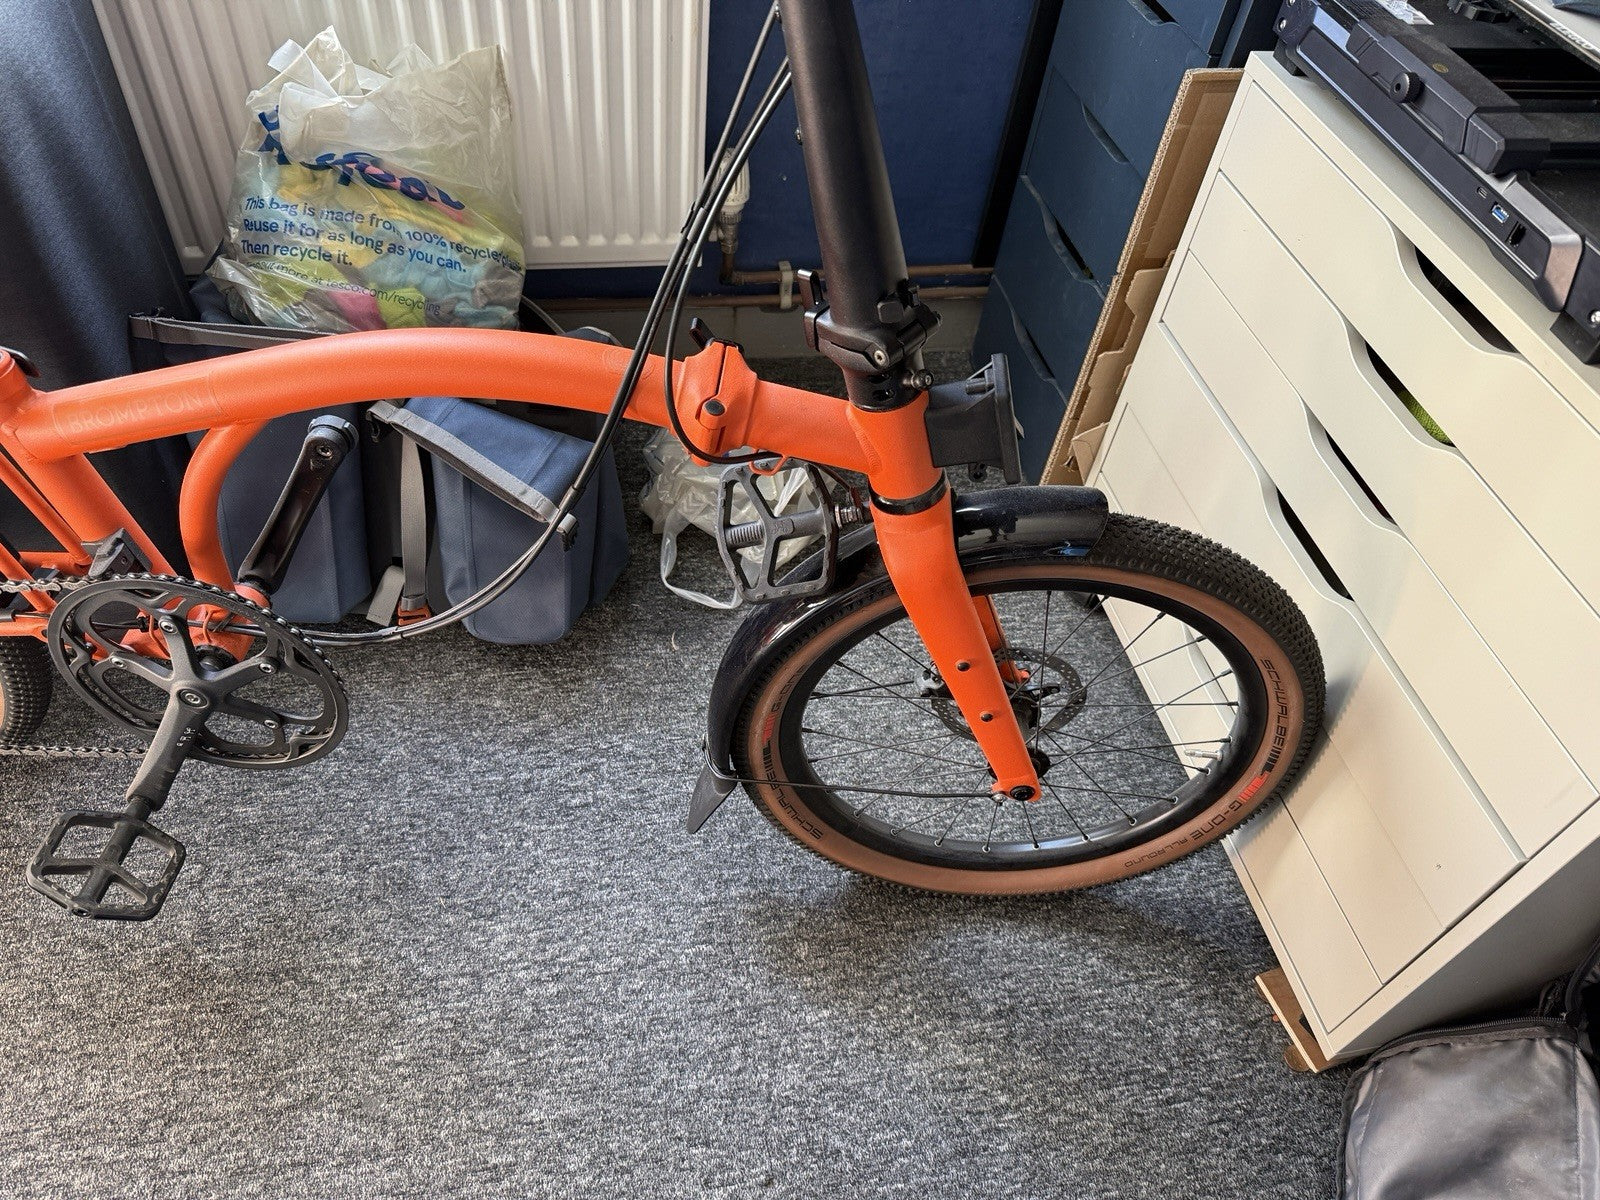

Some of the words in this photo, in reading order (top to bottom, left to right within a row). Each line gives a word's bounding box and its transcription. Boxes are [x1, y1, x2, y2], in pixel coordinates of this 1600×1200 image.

[245, 196, 265, 210] This
[269, 198, 298, 216] bag
[303, 203, 315, 217] is
[320, 209, 364, 223] made
[405, 230, 447, 248] 100%
[241, 239, 270, 255] Then
[273, 244, 332, 261] recycle
[337, 250, 353, 266] it.
[244, 219, 279, 233] Reuse
[283, 219, 295, 235] it
[299, 222, 324, 239] for
[327, 231, 346, 243] as
[350, 231, 383, 255] long
[387, 242, 405, 256] as
[408, 248, 433, 264] you
[436, 256, 467, 273] can.
[275, 264, 308, 279] more
[311, 276, 323, 285] at
[326, 278, 440, 316] tesco.com/recycling
[69, 391, 204, 434] BROMPTON
[1260, 659, 1288, 747] SCHWALBE
[1193, 800, 1243, 841] G-ONE
[1124, 837, 1188, 868] ALLROUND
